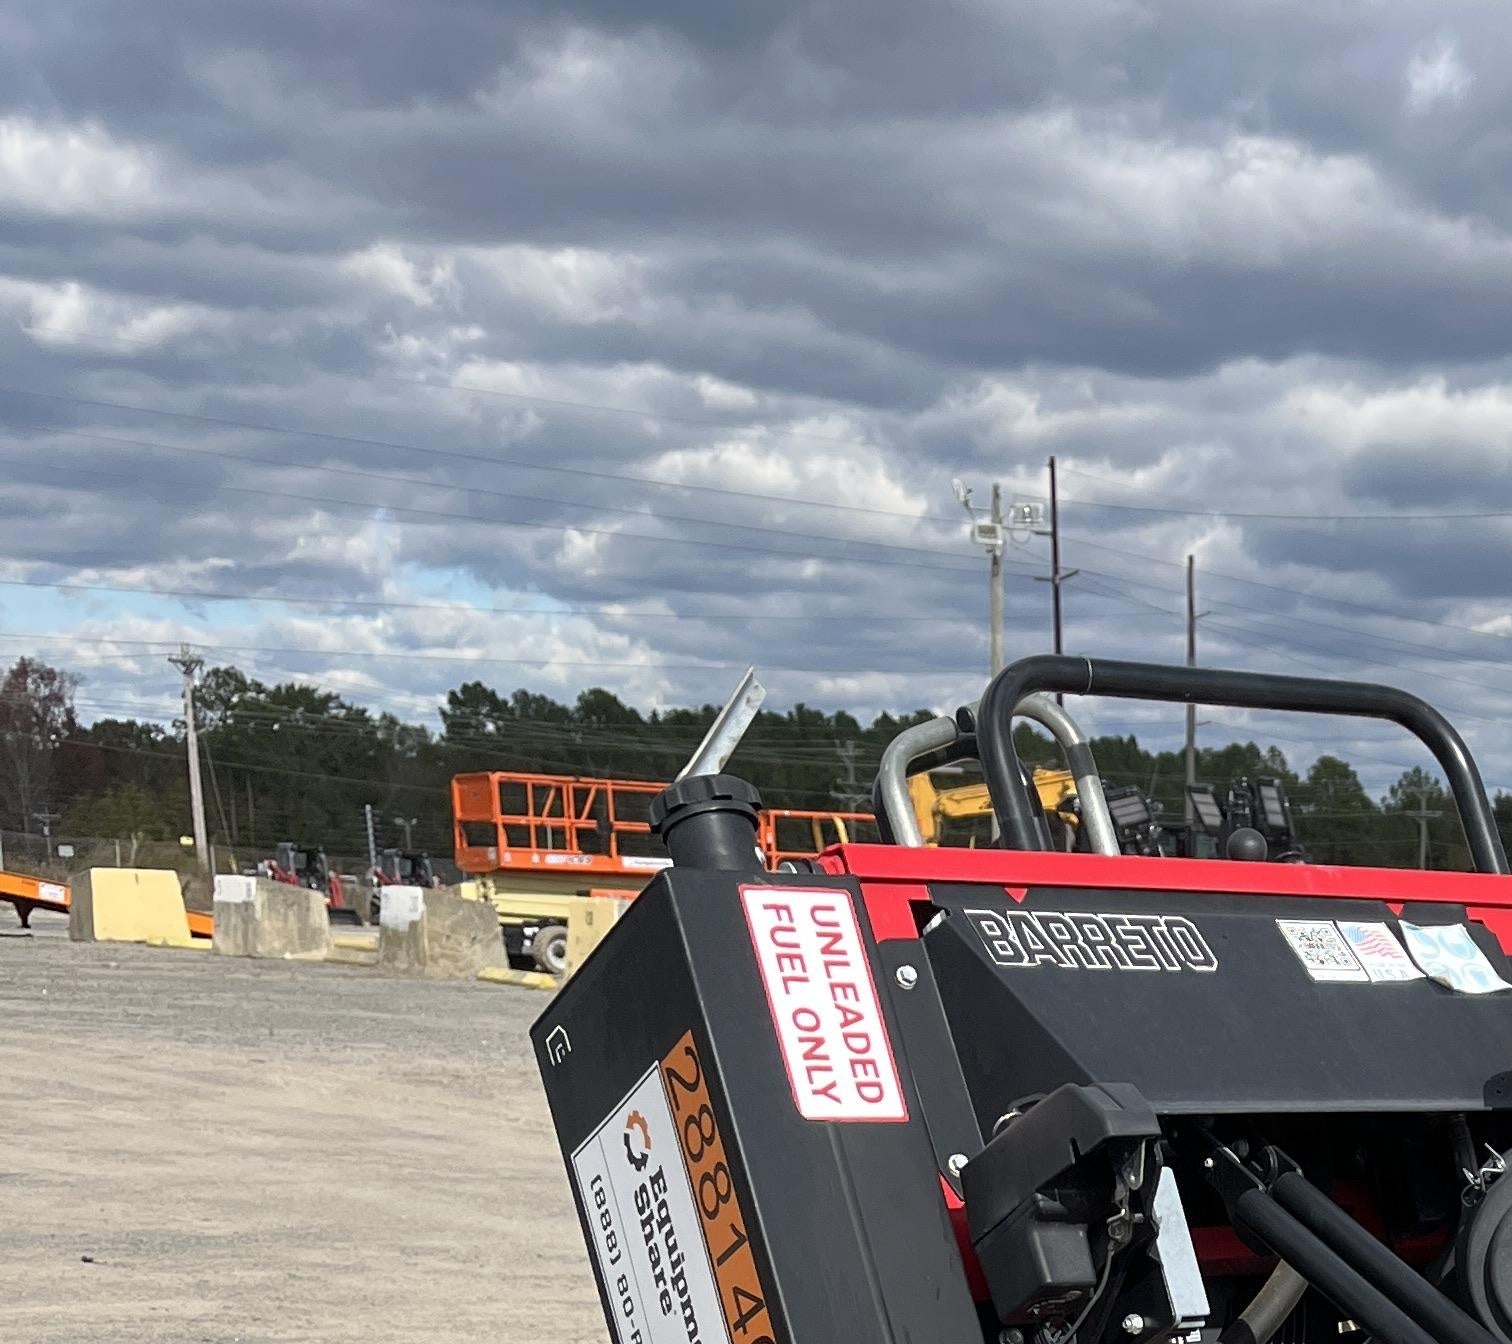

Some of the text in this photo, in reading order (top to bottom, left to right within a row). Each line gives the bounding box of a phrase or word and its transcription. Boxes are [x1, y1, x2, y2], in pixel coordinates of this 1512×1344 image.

[762, 903, 842, 1104] FUEL ONLY
[810, 904, 885, 1104] UNLEADED
[963, 908, 1218, 972] BARRETO
[591, 1174, 622, 1266] (888)
[634, 1182, 673, 1316] Share
